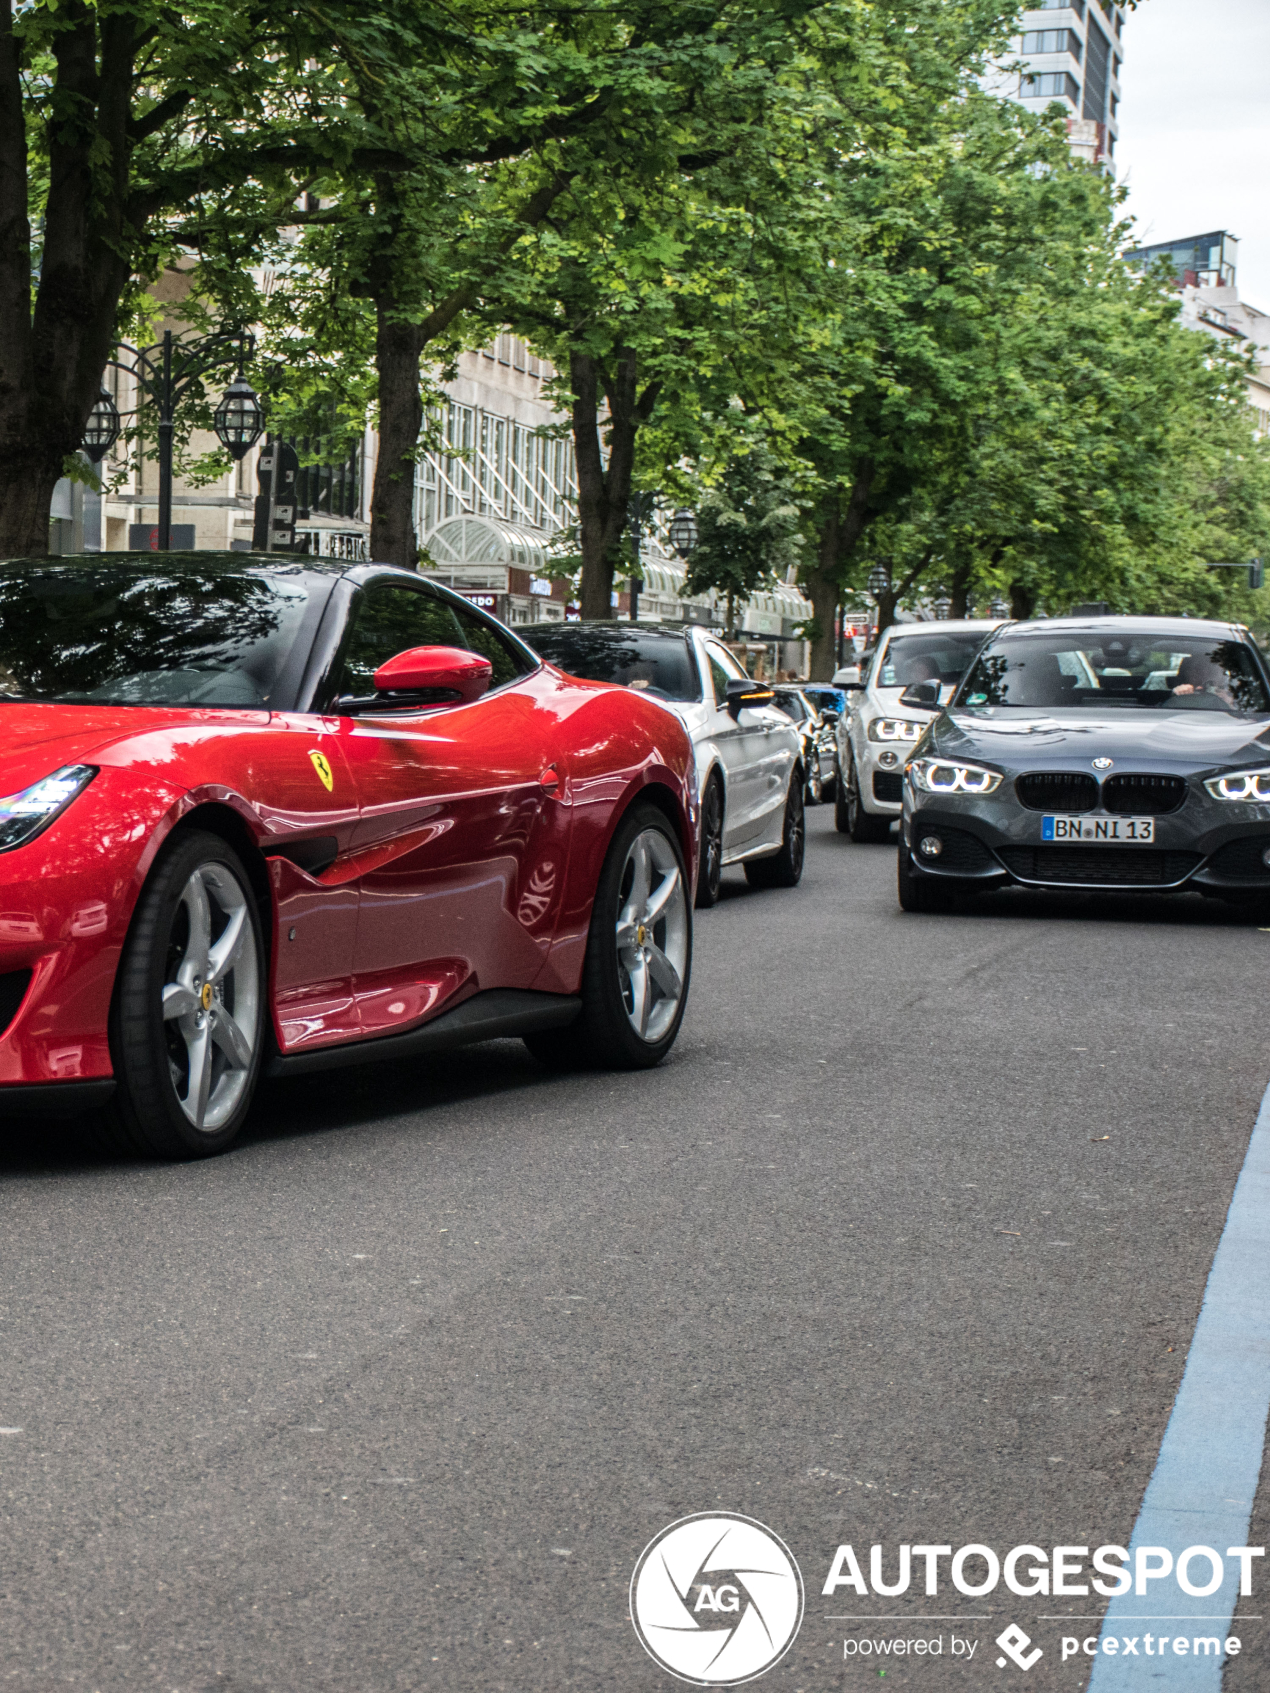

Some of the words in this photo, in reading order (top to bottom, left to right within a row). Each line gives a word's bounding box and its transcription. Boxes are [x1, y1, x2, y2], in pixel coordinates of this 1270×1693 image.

[1055, 820, 1082, 838] BN
[1095, 820, 1120, 839] NI
[1126, 821, 1152, 839] 13
